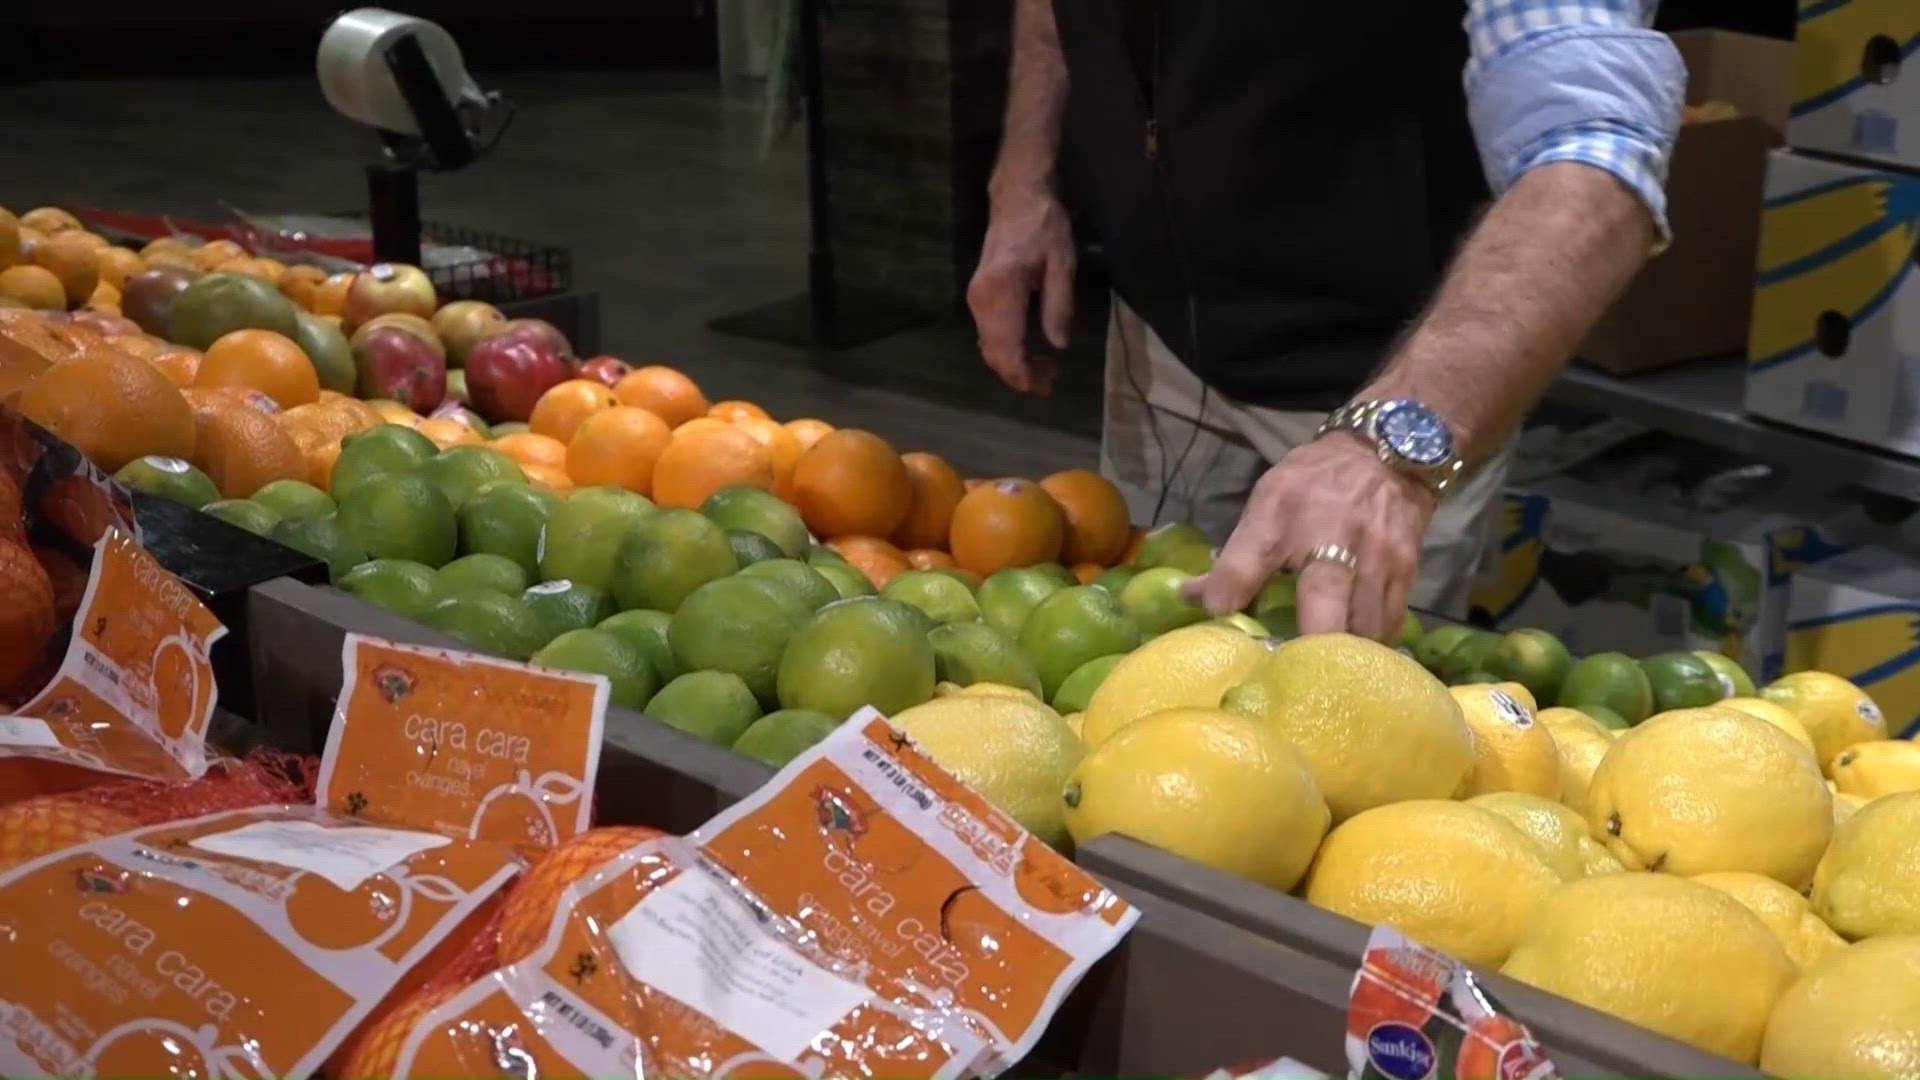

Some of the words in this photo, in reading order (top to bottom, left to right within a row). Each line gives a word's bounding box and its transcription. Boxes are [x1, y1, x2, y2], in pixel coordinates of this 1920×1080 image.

[404, 713, 467, 751] cara
[475, 728, 530, 763] cara
[79, 901, 155, 955] cara
[156, 950, 236, 1019] cara
[824, 848, 896, 918] cara
[896, 917, 970, 985] cara
